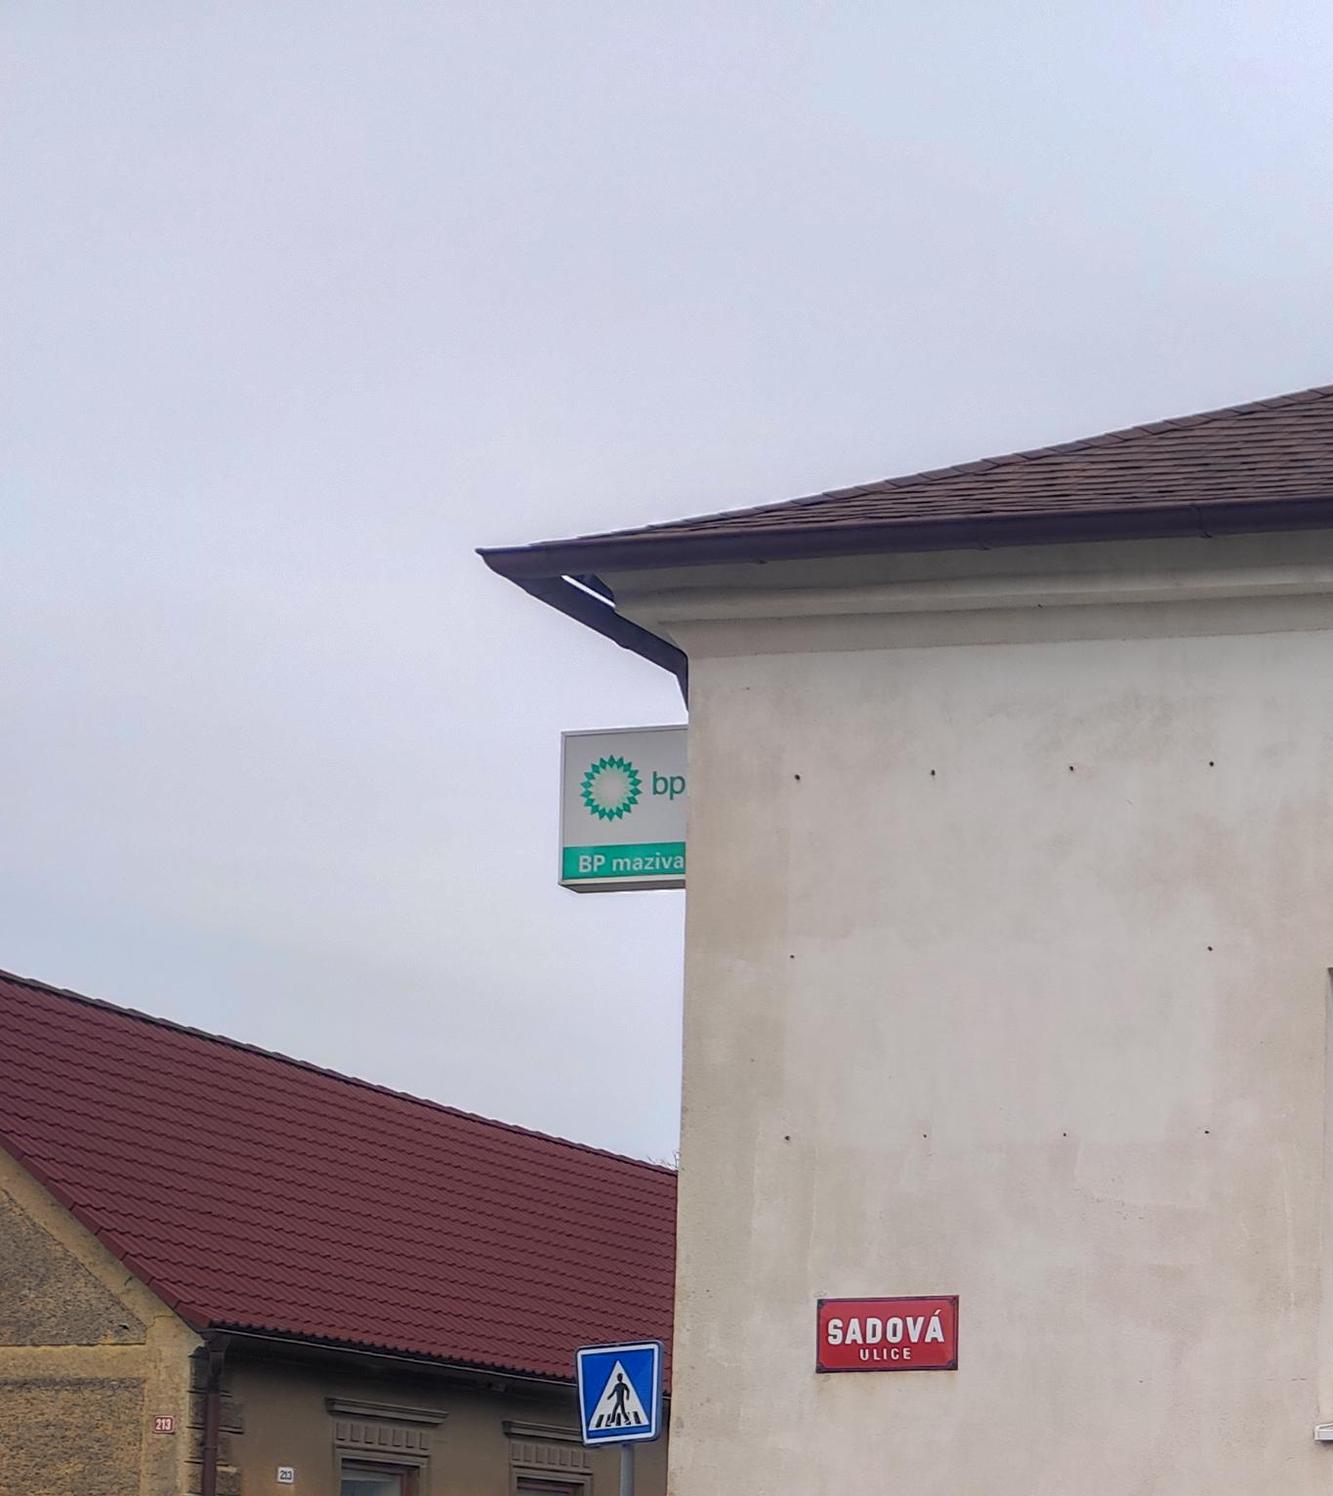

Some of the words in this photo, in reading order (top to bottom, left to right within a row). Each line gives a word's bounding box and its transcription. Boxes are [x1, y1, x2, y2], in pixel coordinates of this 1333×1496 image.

[651, 771, 687, 800] bp
[578, 854, 606, 873] BP
[611, 852, 685, 872] maziva
[827, 1309, 945, 1345] SADOVÁ
[860, 1347, 911, 1361] ULICE
[155, 1418, 172, 1431] 213
